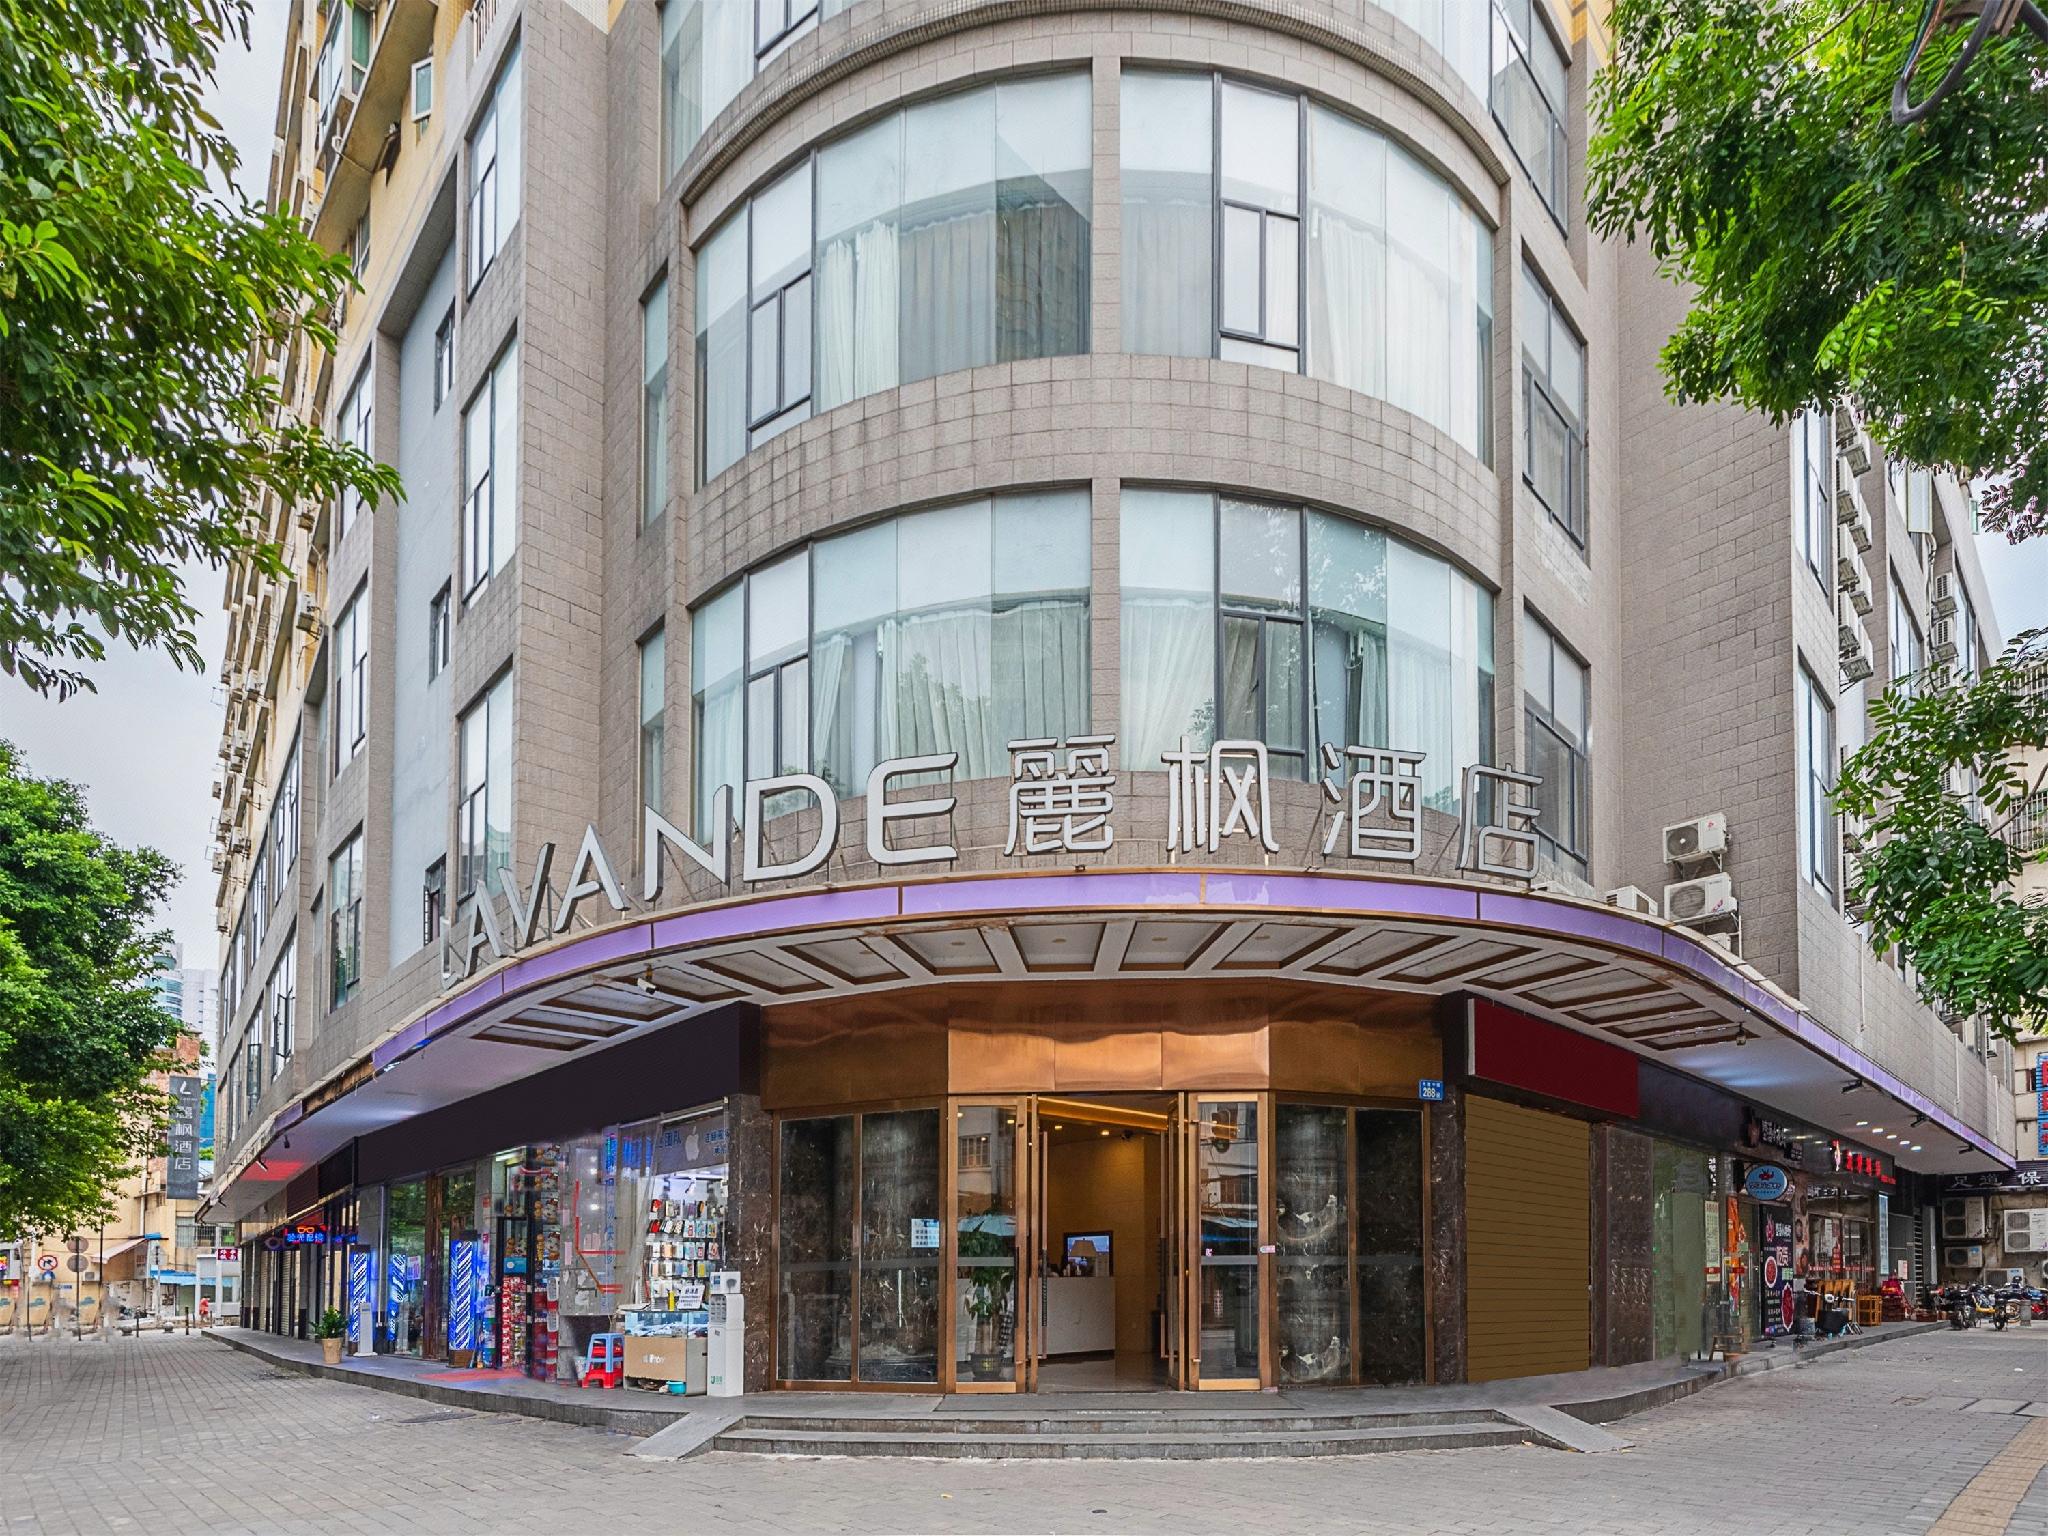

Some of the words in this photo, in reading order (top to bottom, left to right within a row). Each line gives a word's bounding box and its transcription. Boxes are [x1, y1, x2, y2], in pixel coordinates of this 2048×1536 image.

[439, 752, 959, 989] LAVANDE
[1003, 734, 1544, 880] 麗枫酒店
